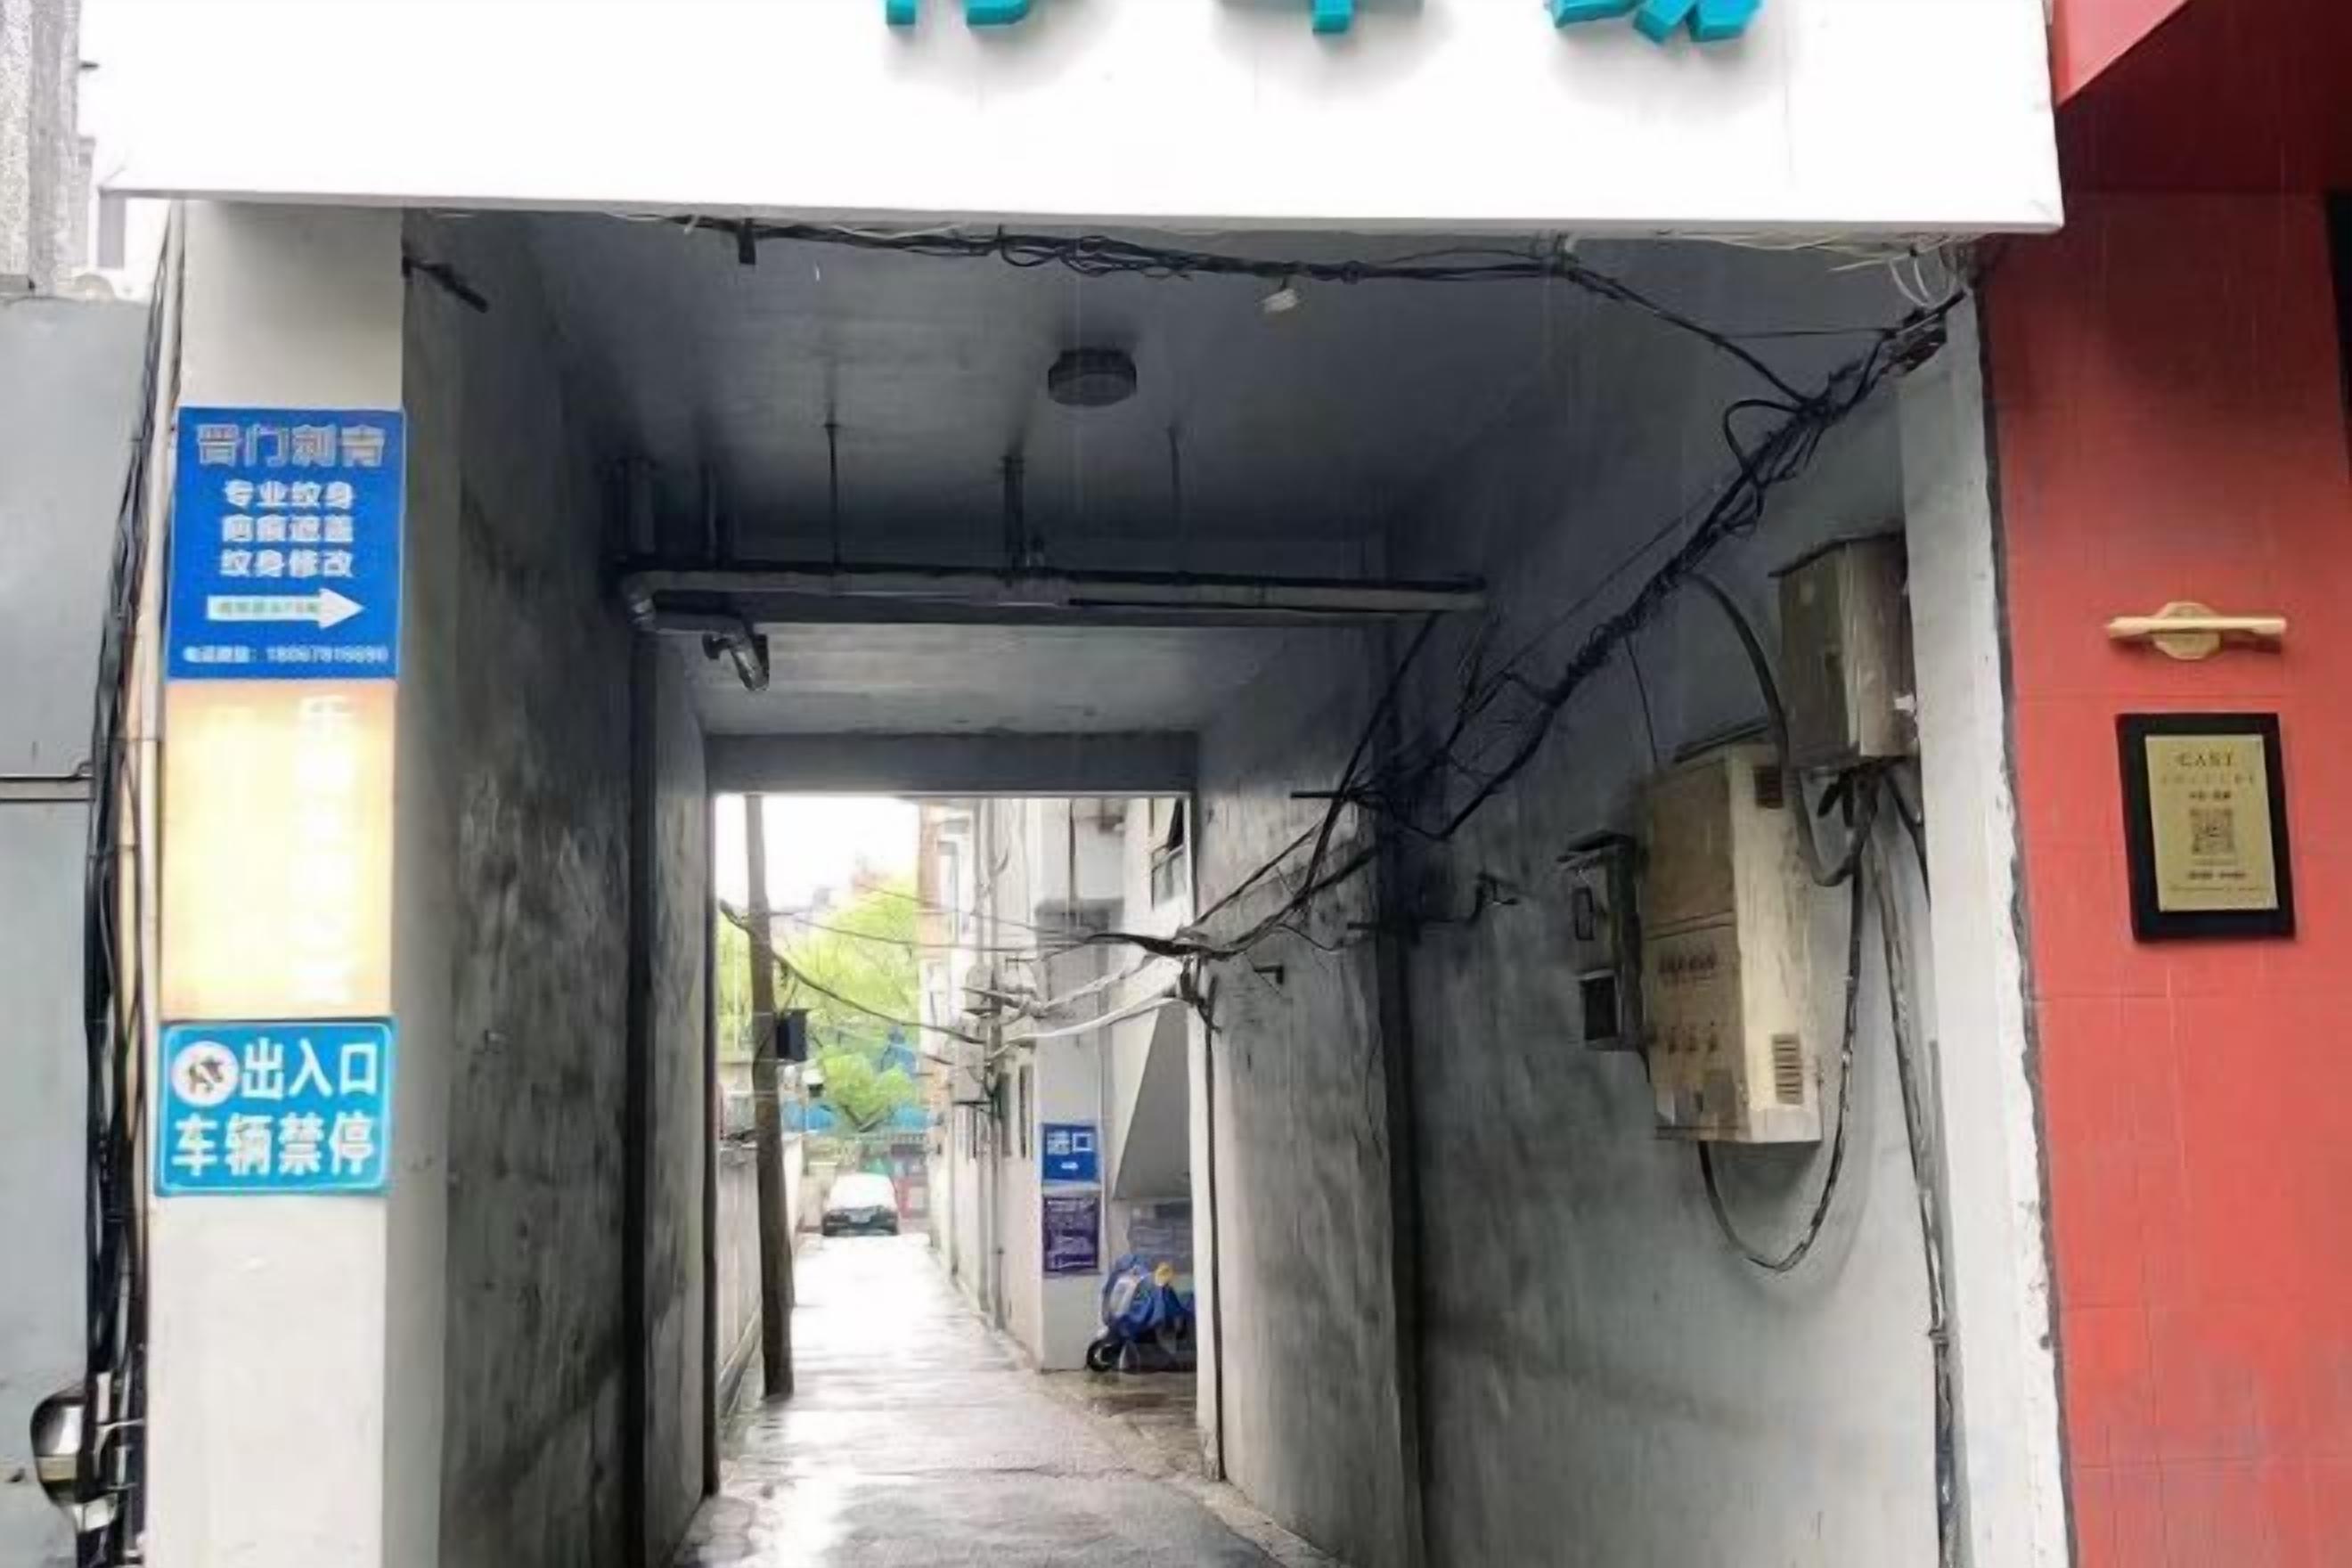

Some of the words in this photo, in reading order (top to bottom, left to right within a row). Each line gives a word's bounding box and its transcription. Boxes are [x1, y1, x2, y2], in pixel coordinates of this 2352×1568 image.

[224, 478, 354, 510] 专业纹身
[219, 548, 354, 578] 纹身修改
[240, 1036, 379, 1101] 出入口
[171, 1111, 376, 1177] 车辆禁停
